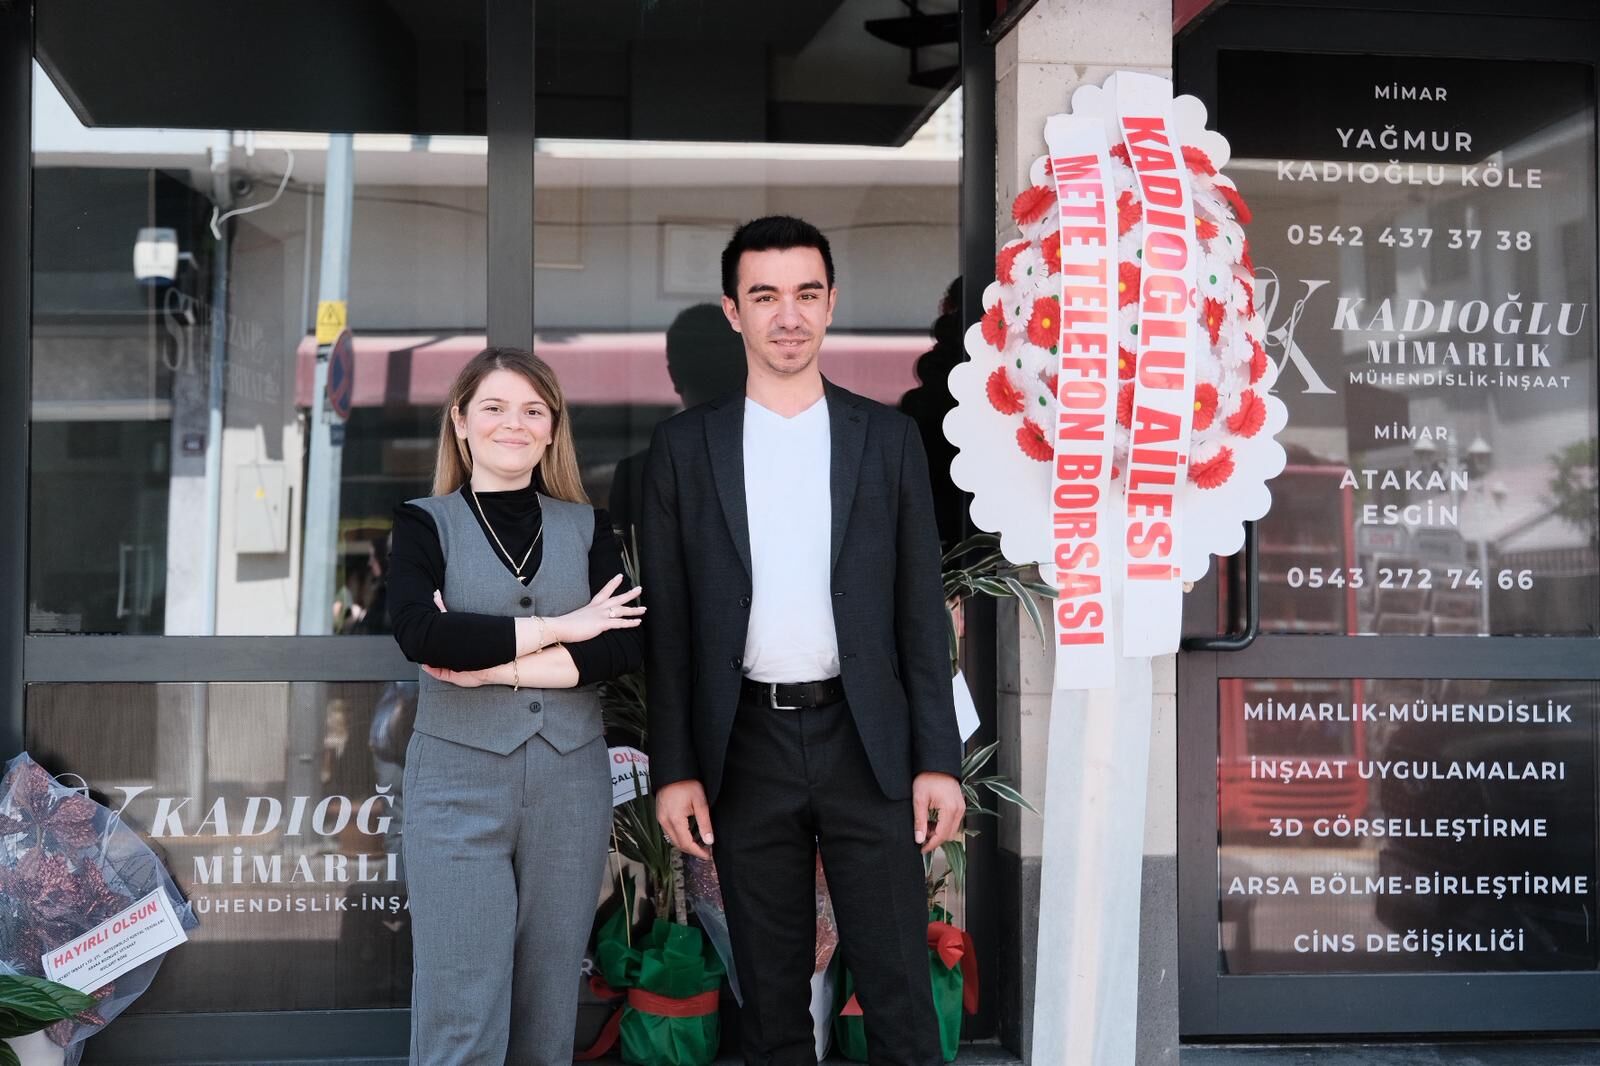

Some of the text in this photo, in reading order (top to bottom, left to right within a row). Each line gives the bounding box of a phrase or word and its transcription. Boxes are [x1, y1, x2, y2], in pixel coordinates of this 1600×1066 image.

[1374, 82, 1448, 102] MİMAR
[1336, 124, 1473, 152] YAĞMUR
[1276, 159, 1543, 189] KADIOĞLU KÖLE
[1286, 224, 1533, 252] 0542 437 37 38
[1330, 292, 1589, 337] KADIOĞLU
[1121, 116, 1198, 581] KADIOĞLU AİLESİ
[1366, 334, 1553, 368] MİMARLIK
[1349, 371, 1572, 391] MÜHENDİSLİK-İNŞAAT
[1052, 154, 1109, 646] METE TELEFON BORSASI
[1374, 421, 1449, 441] MİMAR
[1339, 469, 1470, 492] ATAKAN
[1362, 500, 1459, 526] ESGİN
[1286, 567, 1534, 591] 0543 272 74 66
[1243, 697, 1573, 724] MİMARLIK-MÜHENDİSLİK
[1249, 755, 1566, 784] İNŞAAT UYGULAMALARI
[147, 783, 403, 838] KADIOĞ
[1268, 813, 1548, 843] 3D GÖRSELLEŞTİRME
[191, 846, 399, 885] MİMARLI
[1227, 871, 1590, 900] ARSA BÖLME-BİRLEŞTİRME
[53, 928, 110, 969] HAYIRLI
[111, 900, 158, 935] OLSUN
[1293, 928, 1525, 958] CİNS DEĞİŞİKLİĞİ
